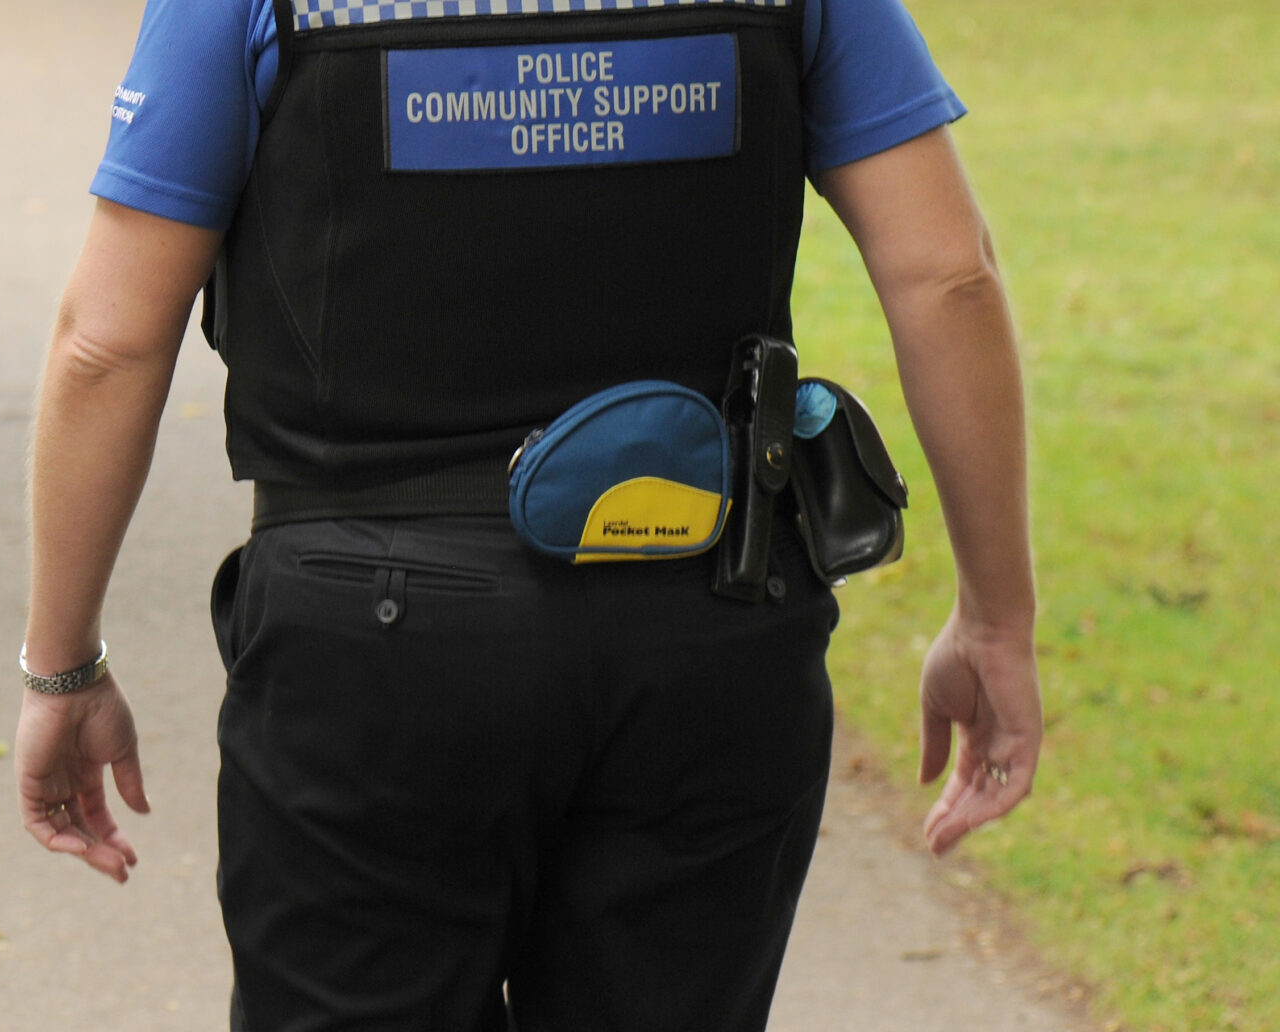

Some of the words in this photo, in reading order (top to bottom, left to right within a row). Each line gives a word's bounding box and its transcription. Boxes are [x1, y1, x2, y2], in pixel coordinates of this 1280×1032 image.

[517, 51, 614, 85] POLICE
[406, 87, 583, 123] COMMUNITY
[594, 82, 721, 117] SUPPORT
[511, 121, 625, 155] OFFICER
[602, 526, 650, 536] Pocket
